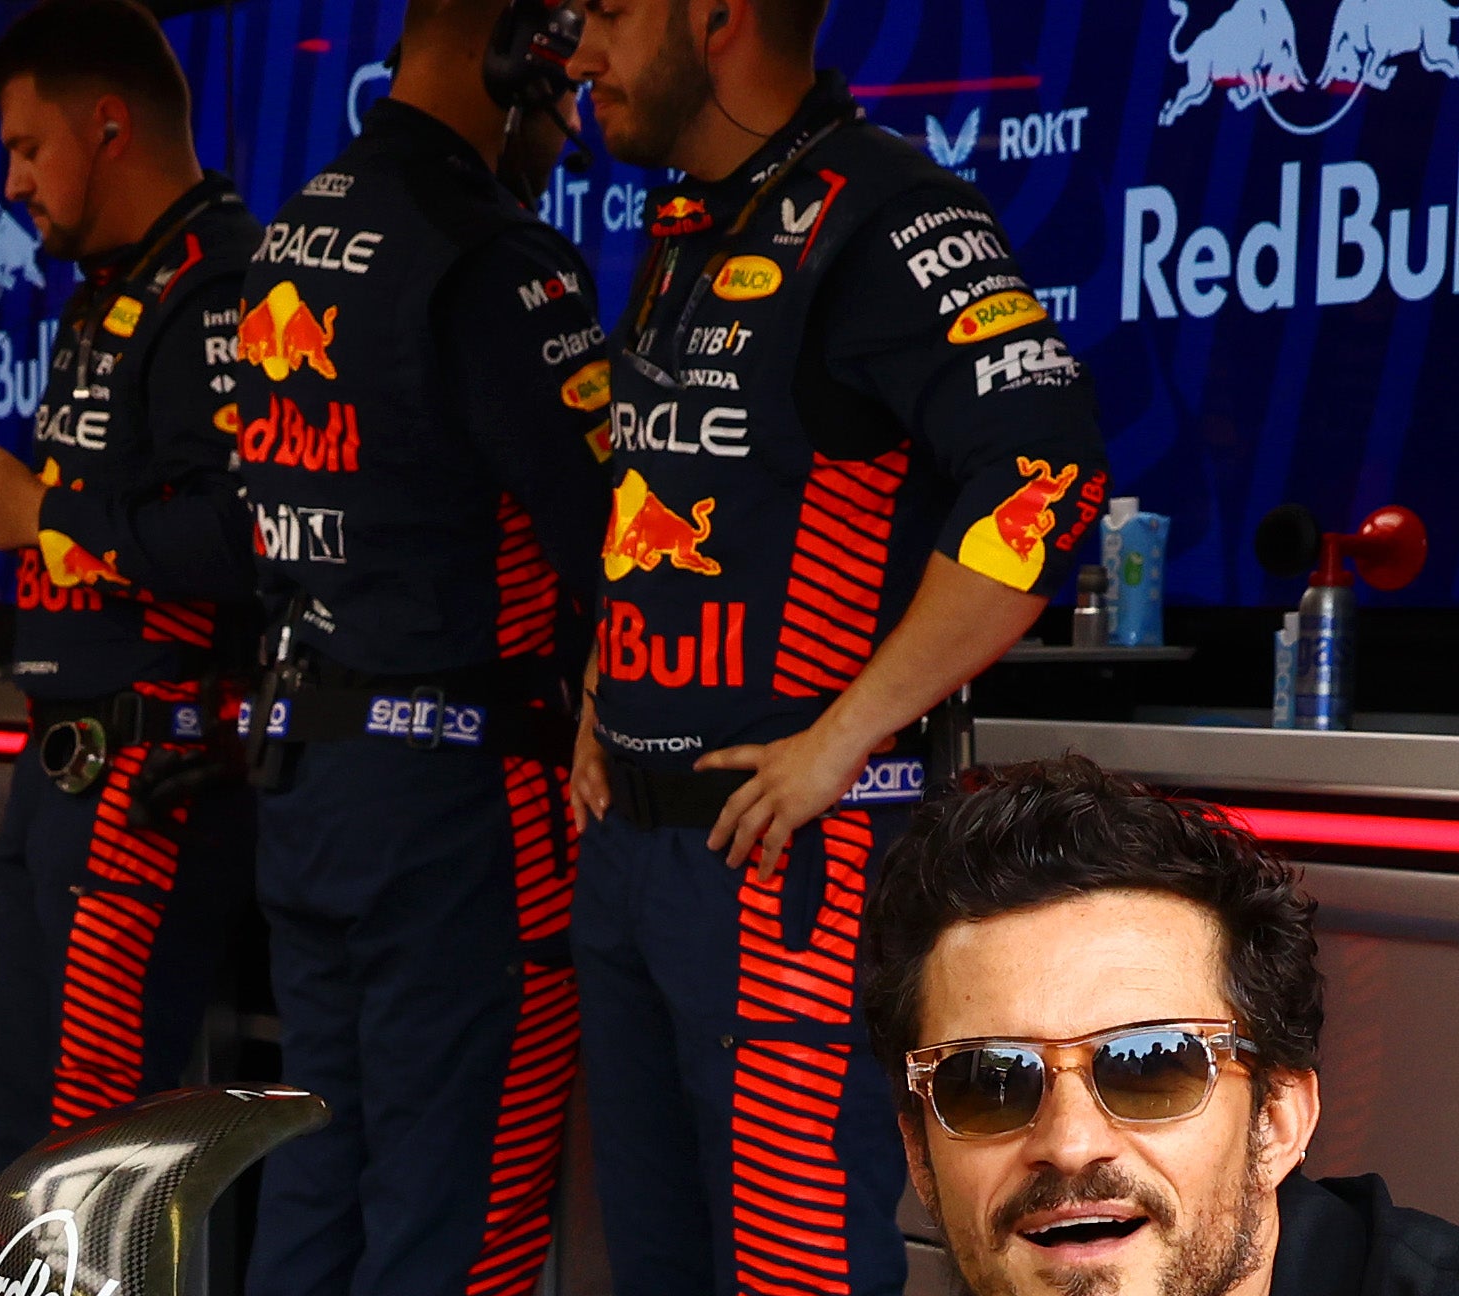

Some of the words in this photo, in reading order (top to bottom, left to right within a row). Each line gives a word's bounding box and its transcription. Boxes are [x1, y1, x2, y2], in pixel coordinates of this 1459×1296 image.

[999, 106, 1089, 162] ROKT
[1120, 162, 1300, 321] Red
[542, 324, 606, 365] Claro
[685, 320, 754, 356] BYBIT
[1080, 469, 1108, 504] Bu
[609, 599, 747, 689] Bull
